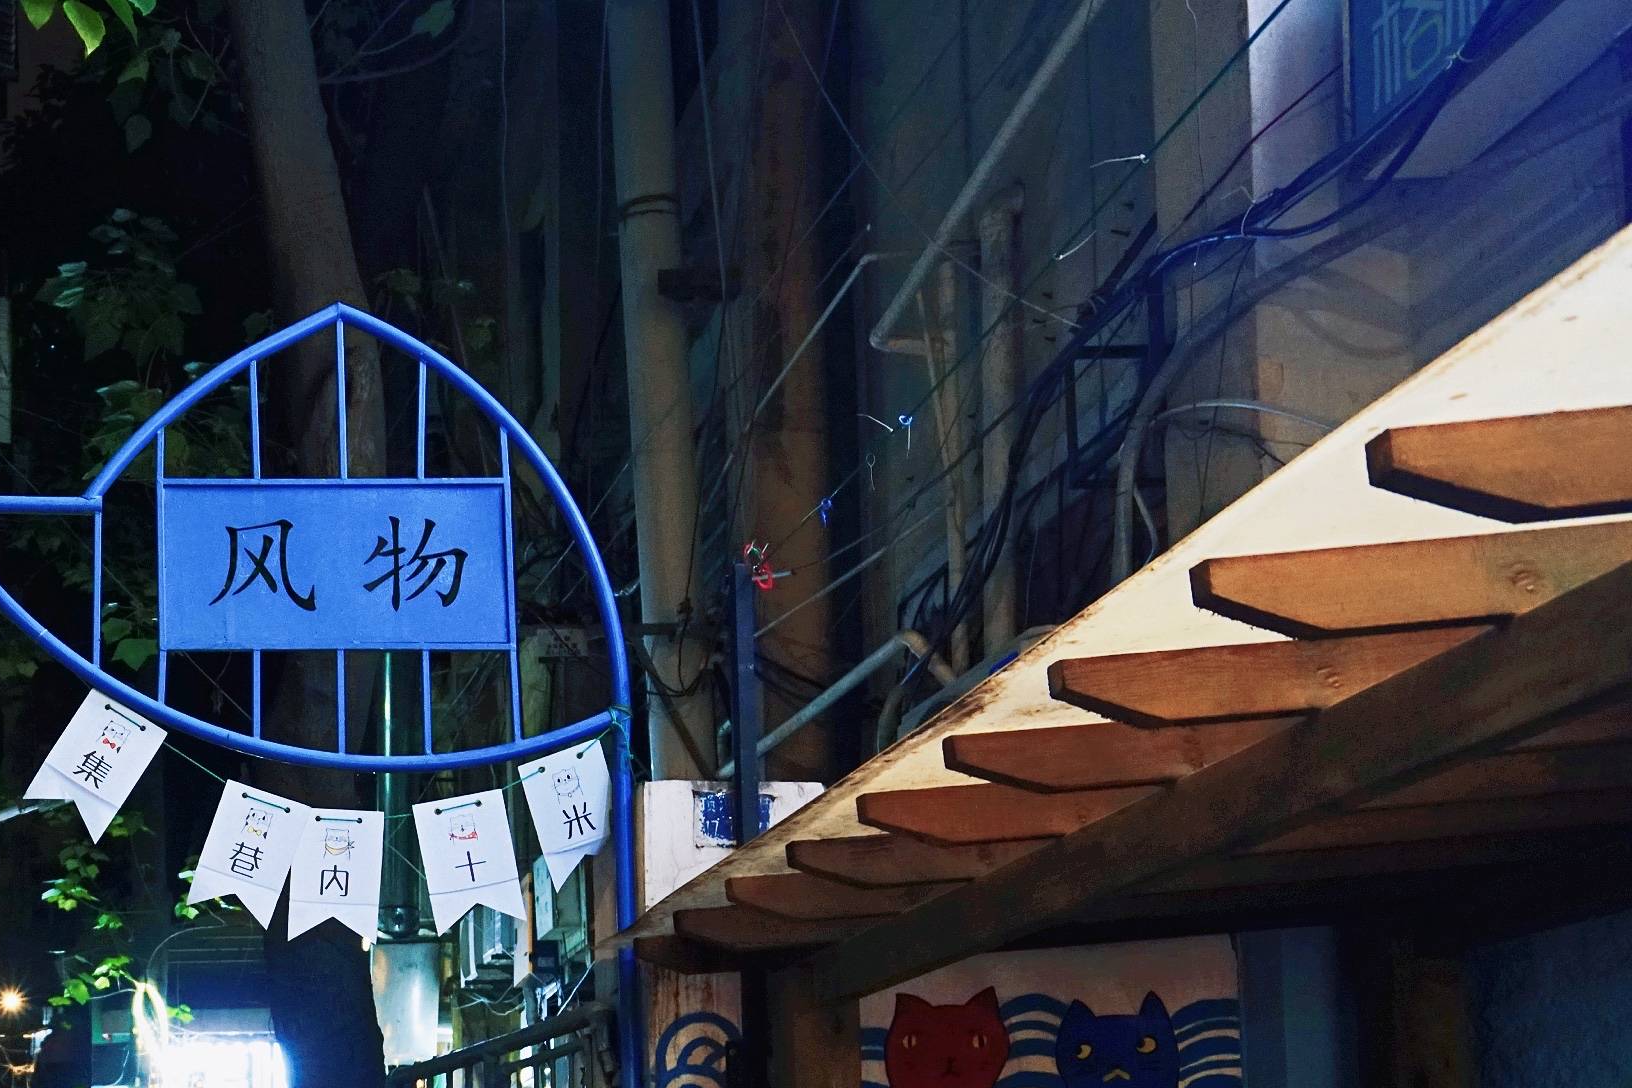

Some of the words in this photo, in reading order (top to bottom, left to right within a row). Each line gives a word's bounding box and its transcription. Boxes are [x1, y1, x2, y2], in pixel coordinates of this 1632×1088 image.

[209, 515, 467, 612] 风物
[72, 749, 113, 790] 集
[228, 841, 264, 880] 巷
[320, 865, 349, 897] 内
[455, 850, 487, 882] 十
[562, 800, 594, 839] 米
